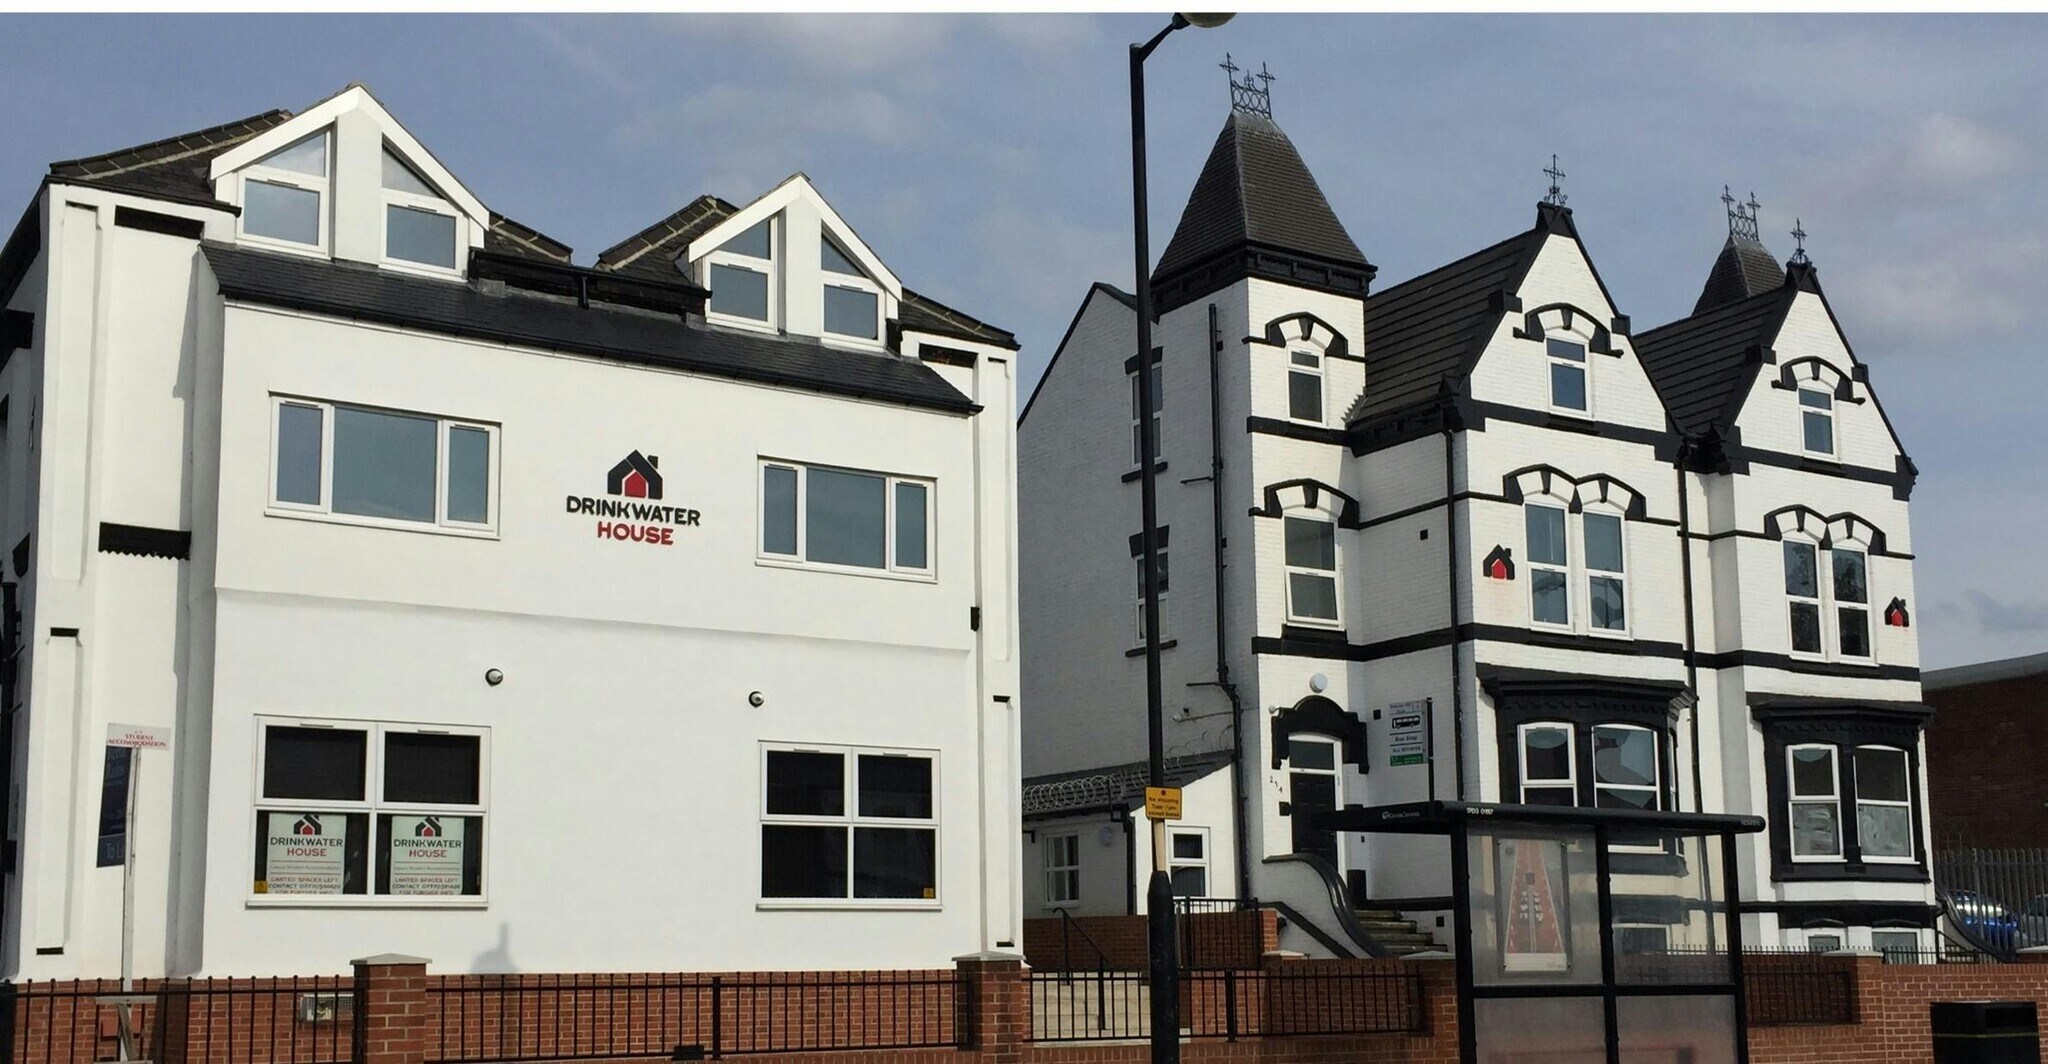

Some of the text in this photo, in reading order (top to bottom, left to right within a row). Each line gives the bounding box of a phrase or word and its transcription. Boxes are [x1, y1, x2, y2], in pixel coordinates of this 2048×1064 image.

[566, 495, 701, 527] DRINKWATER
[597, 521, 674, 546] HOUSE
[125, 733, 154, 741] STUDENT
[270, 836, 344, 847] DRINKWATER
[393, 838, 462, 848] DRINKWATER
[287, 848, 327, 857] HOUSE
[408, 849, 447, 858] HOUSE
